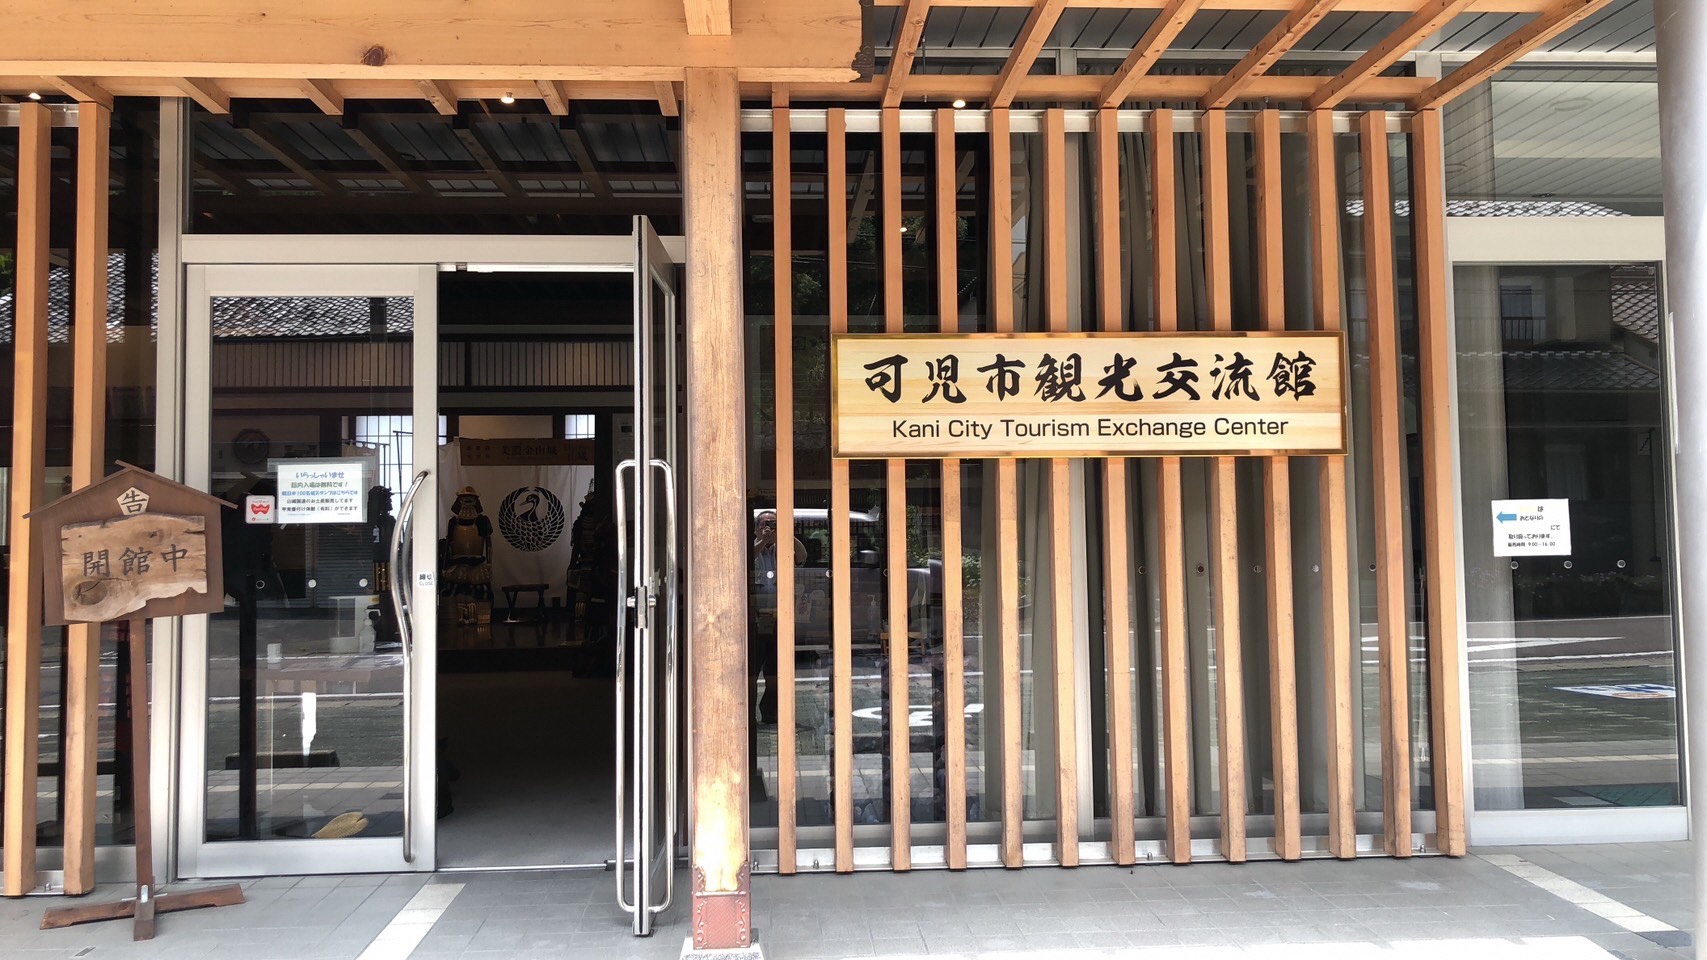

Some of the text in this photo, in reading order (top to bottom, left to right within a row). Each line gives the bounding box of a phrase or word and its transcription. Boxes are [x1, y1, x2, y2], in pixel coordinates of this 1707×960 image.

[863, 351, 1317, 403] 可児市観光交流館
[892, 417, 1289, 440] Kani City Tourism Exchange Center
[296, 471, 344, 479] いらっしゃいませ
[121, 490, 147, 513] 告
[83, 544, 188, 577] 開館中
